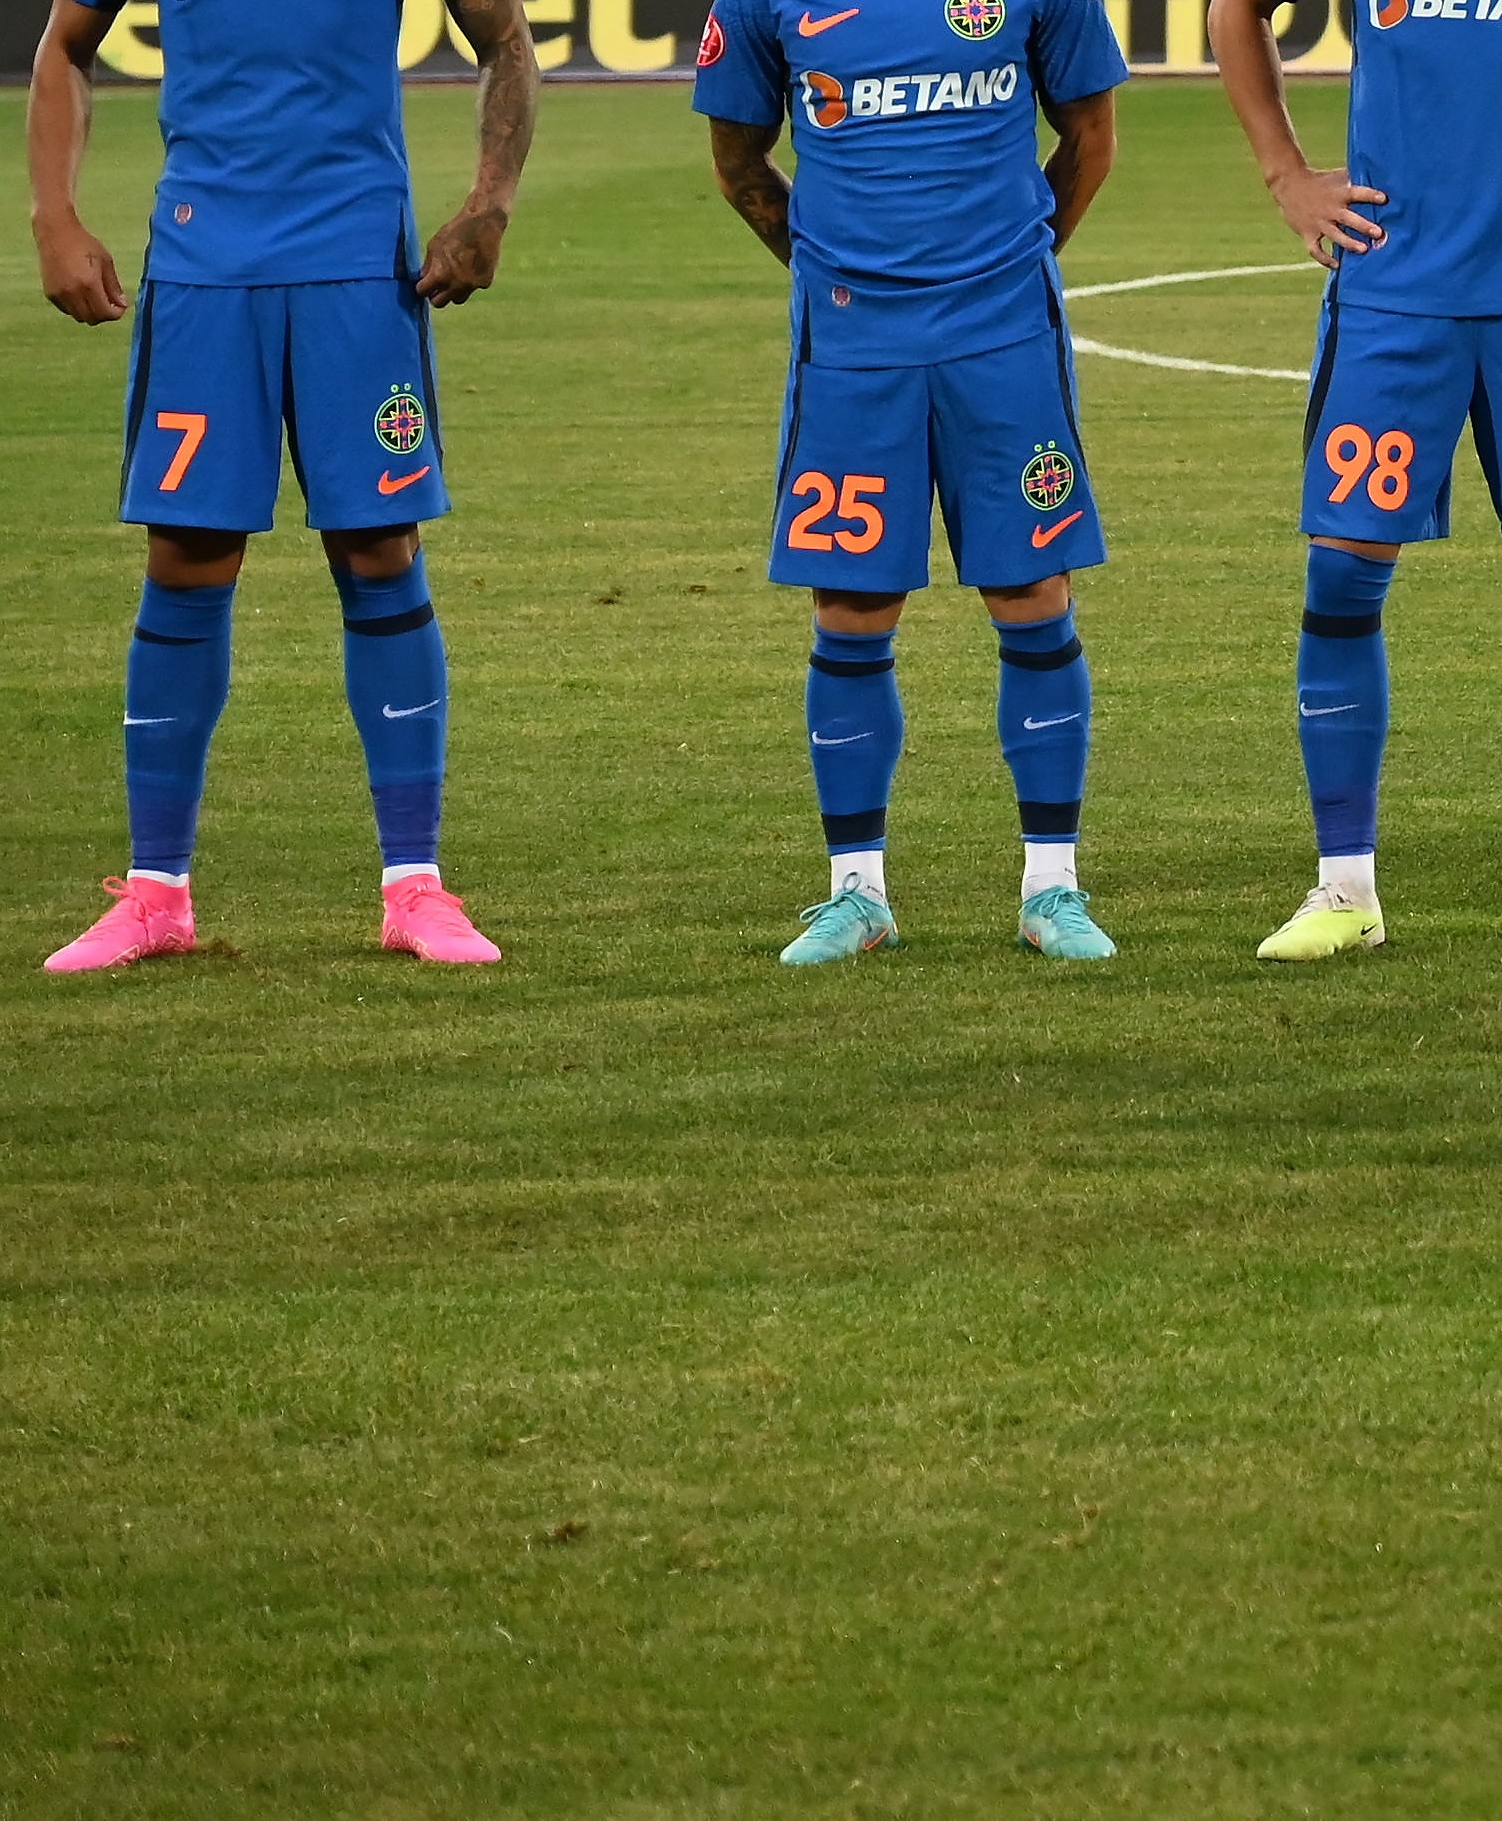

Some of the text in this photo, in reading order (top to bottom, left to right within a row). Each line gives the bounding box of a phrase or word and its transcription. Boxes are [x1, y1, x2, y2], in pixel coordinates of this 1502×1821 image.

[852, 63, 1018, 116] BETANO
[157, 412, 207, 491] 7
[1325, 423, 1415, 511] 98
[788, 470, 887, 554] 25
